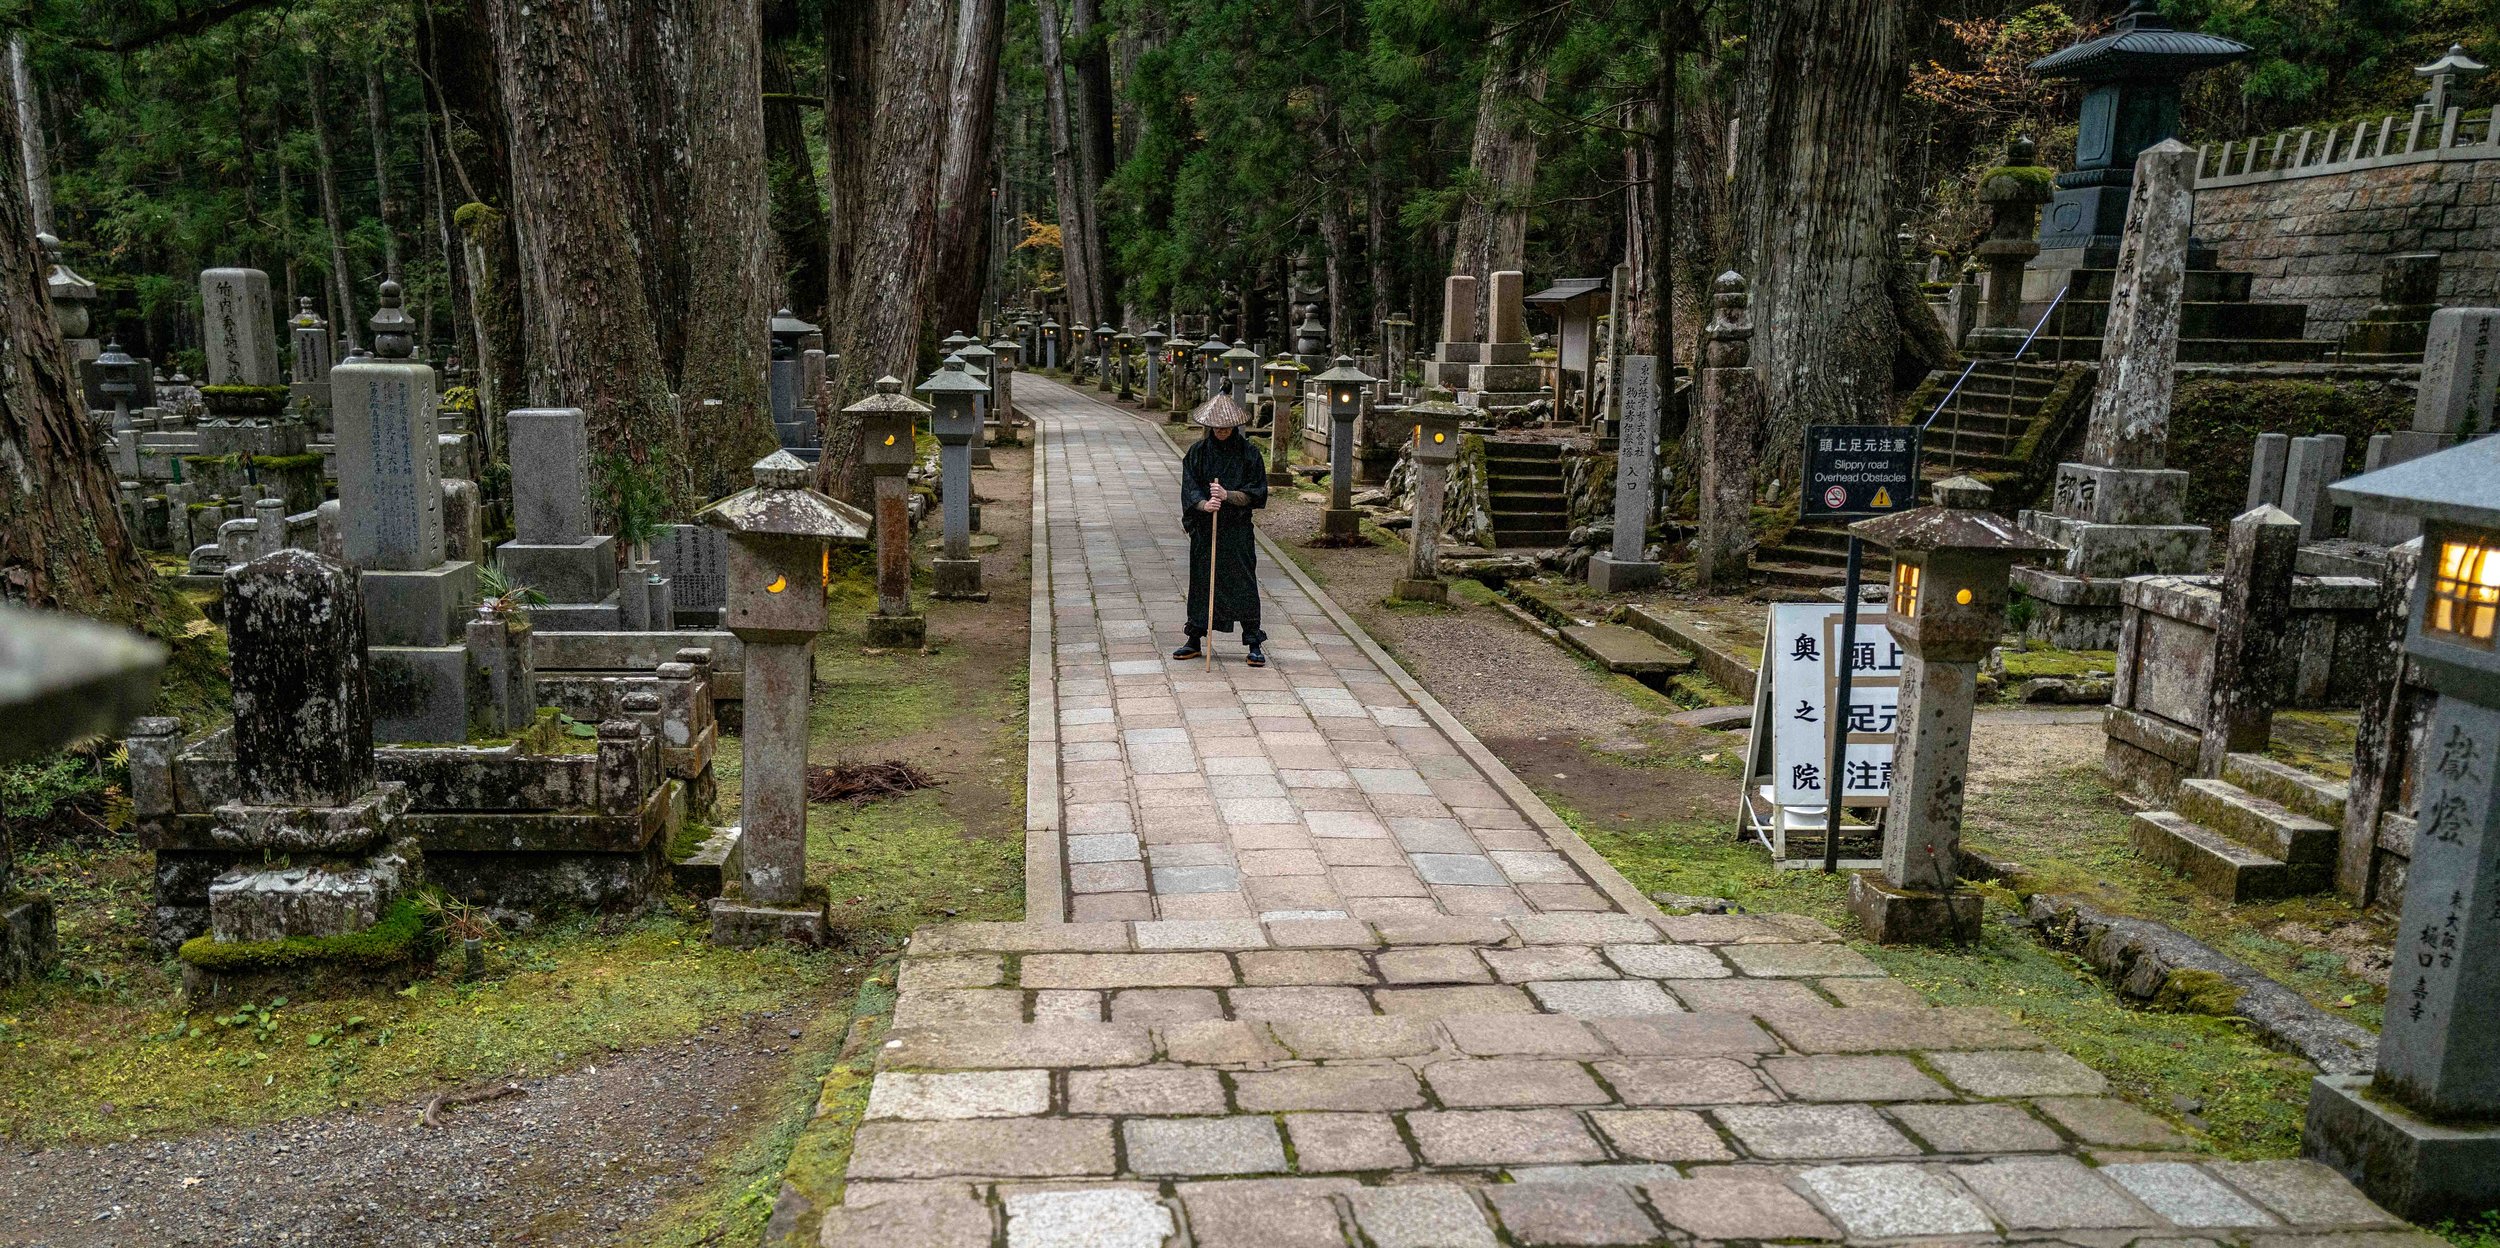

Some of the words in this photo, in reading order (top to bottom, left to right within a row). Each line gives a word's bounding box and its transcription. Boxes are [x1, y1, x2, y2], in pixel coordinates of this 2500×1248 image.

[1819, 438, 1907, 453] 頭上足元注意
[1834, 459, 1866, 471] Slippry
[1867, 460, 1889, 469] road
[1627, 466, 1639, 491] 入口
[1814, 472, 1860, 482] Overhead
[1861, 472, 1907, 482] Obstacles
[1852, 642, 1904, 671] 頭上
[1790, 633, 1821, 790] 奥之院
